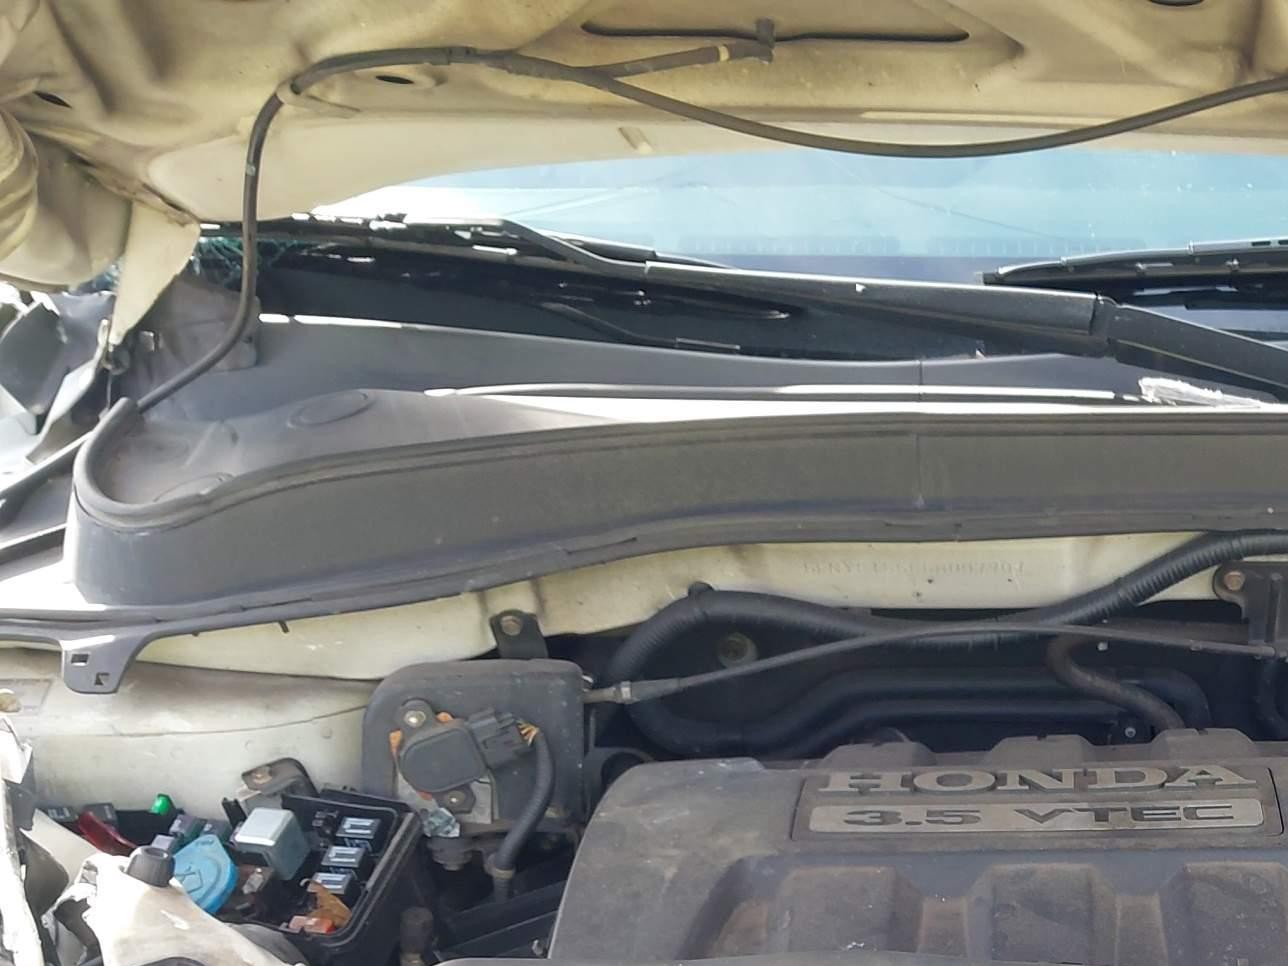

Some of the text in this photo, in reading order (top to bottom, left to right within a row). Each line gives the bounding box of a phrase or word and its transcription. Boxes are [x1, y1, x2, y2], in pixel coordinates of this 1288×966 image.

[818, 765, 1257, 793] HONDA
[843, 804, 1235, 827] 3.5 VTEC
